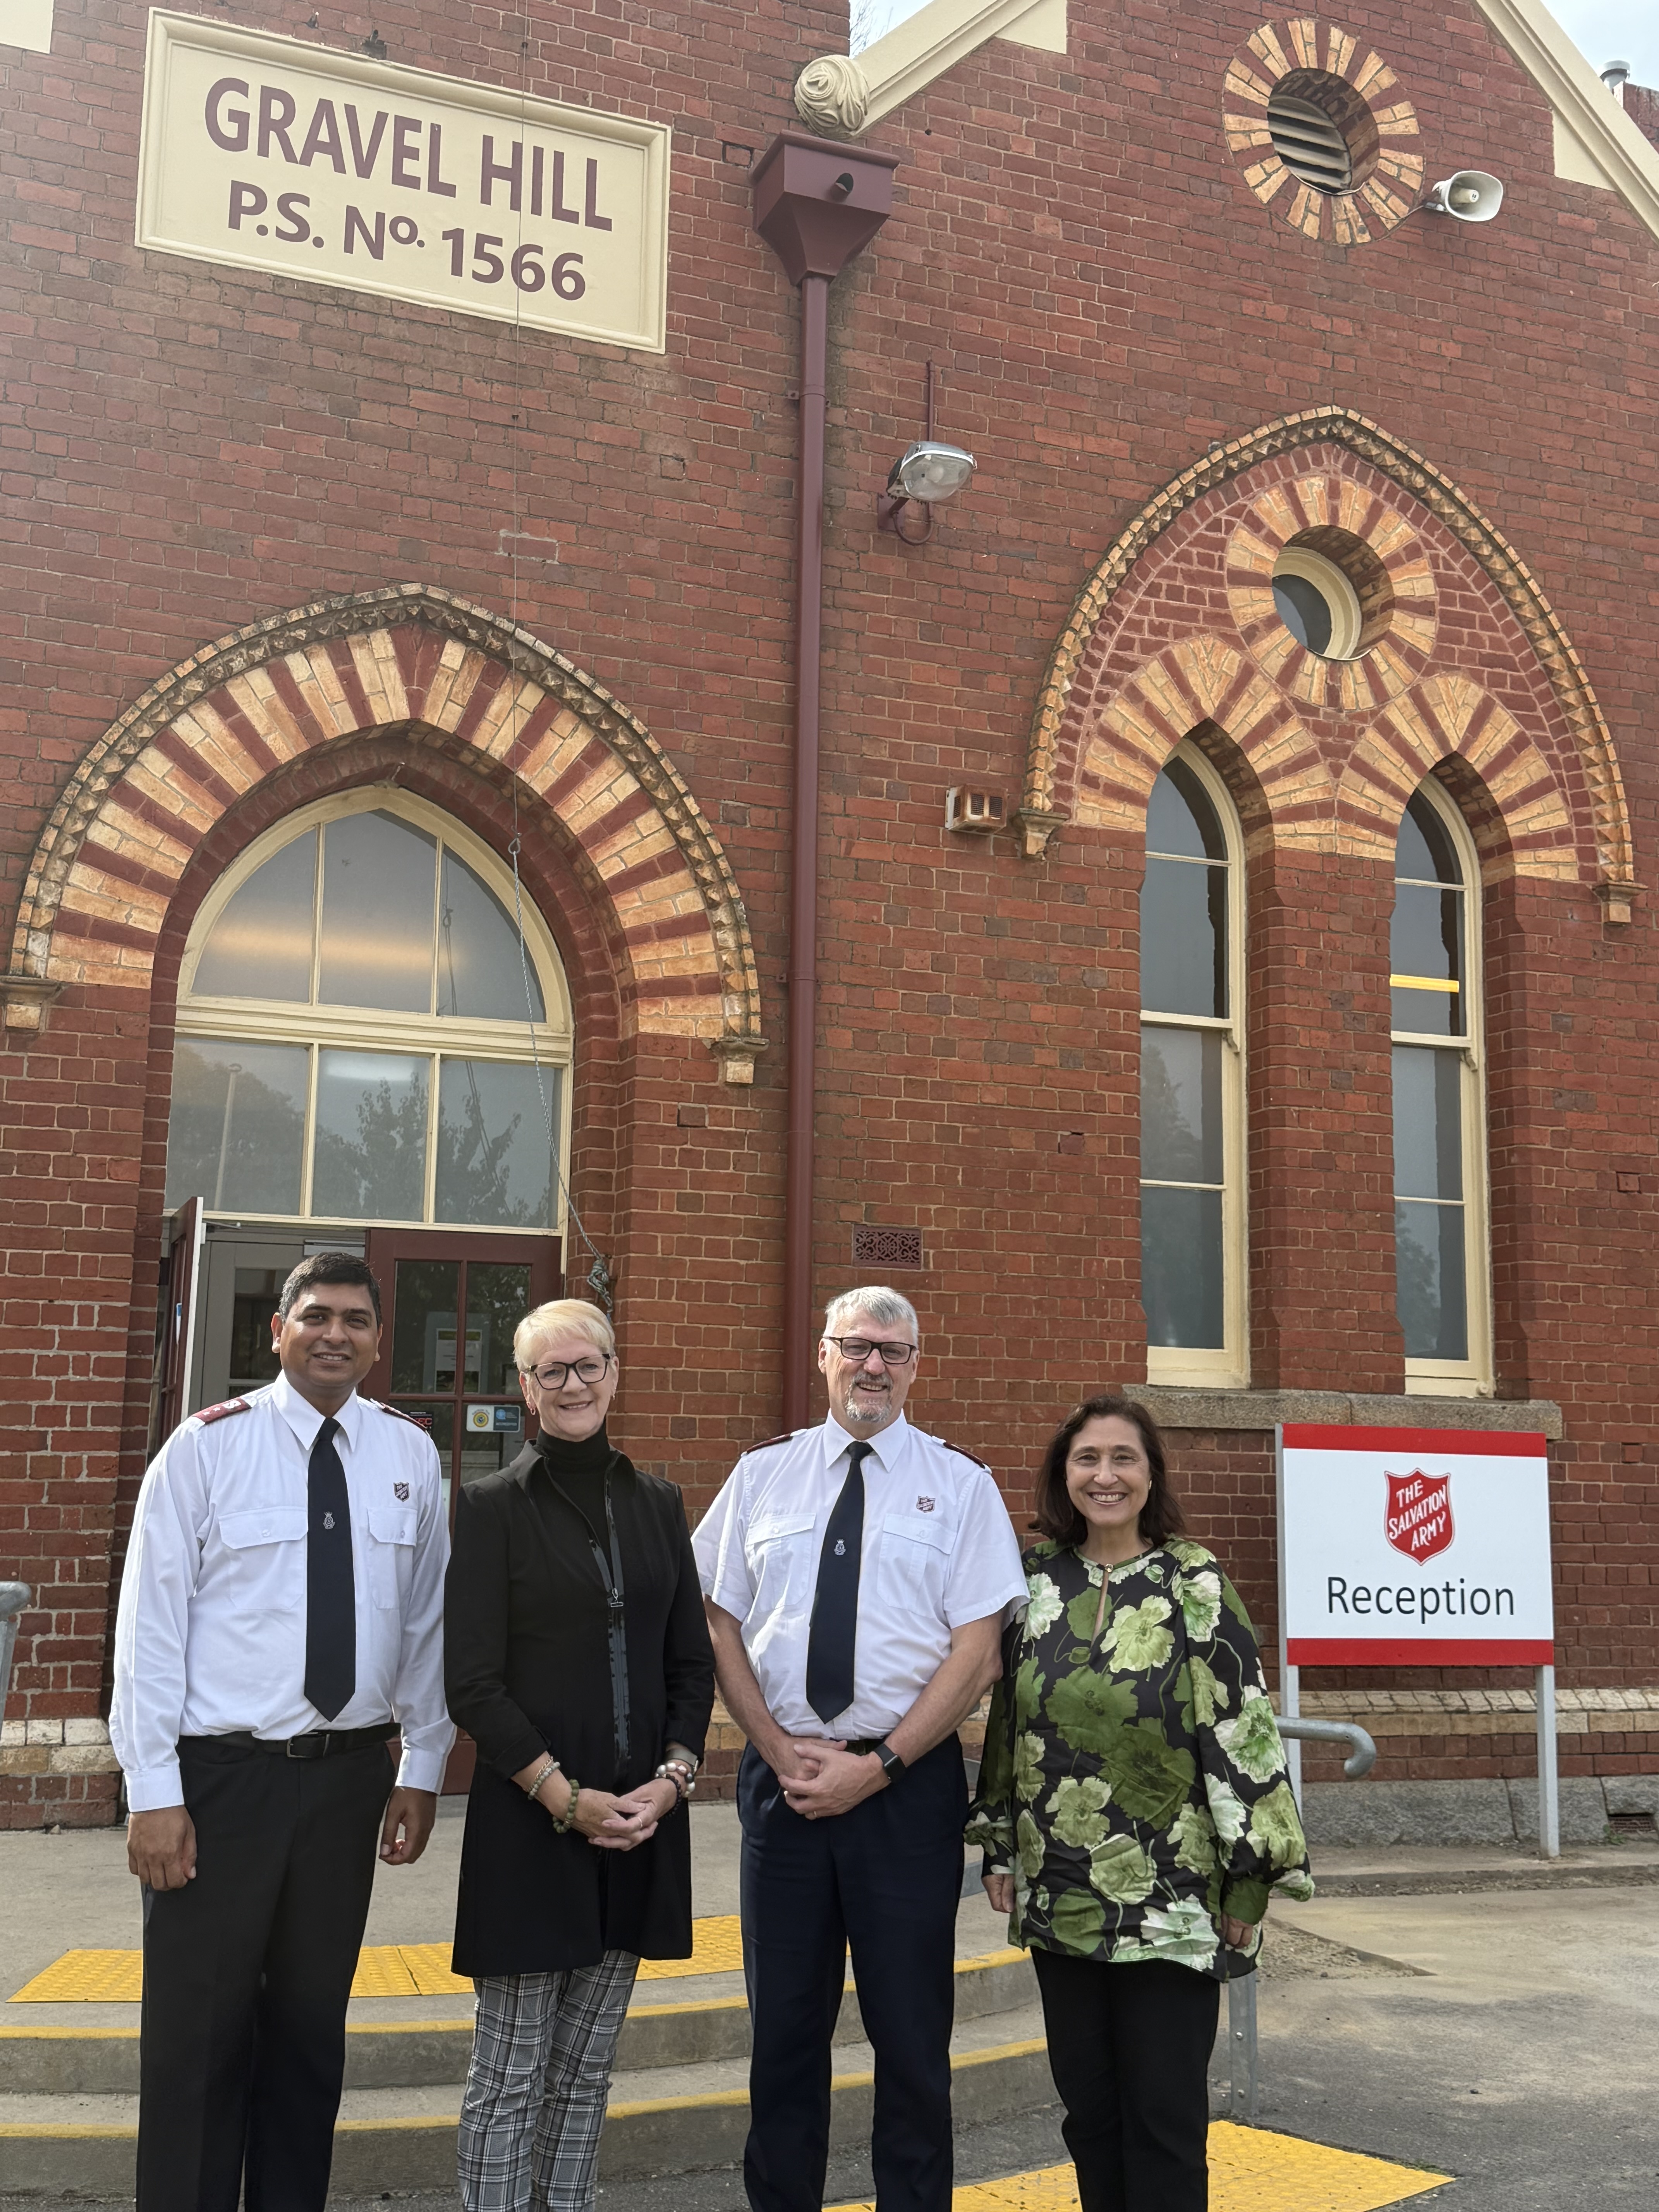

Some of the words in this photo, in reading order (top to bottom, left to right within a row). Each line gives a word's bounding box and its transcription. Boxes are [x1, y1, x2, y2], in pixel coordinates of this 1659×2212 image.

[205, 77, 457, 198] GRAVEL
[480, 134, 612, 232] HILL
[228, 180, 324, 248] P.S.
[442, 228, 586, 301] 1566
[1389, 1484, 1447, 1540] SALVATION
[1396, 1479, 1424, 1508] THE
[1411, 1511, 1446, 1551] ARMY
[1328, 1577, 1514, 1624] Reception
